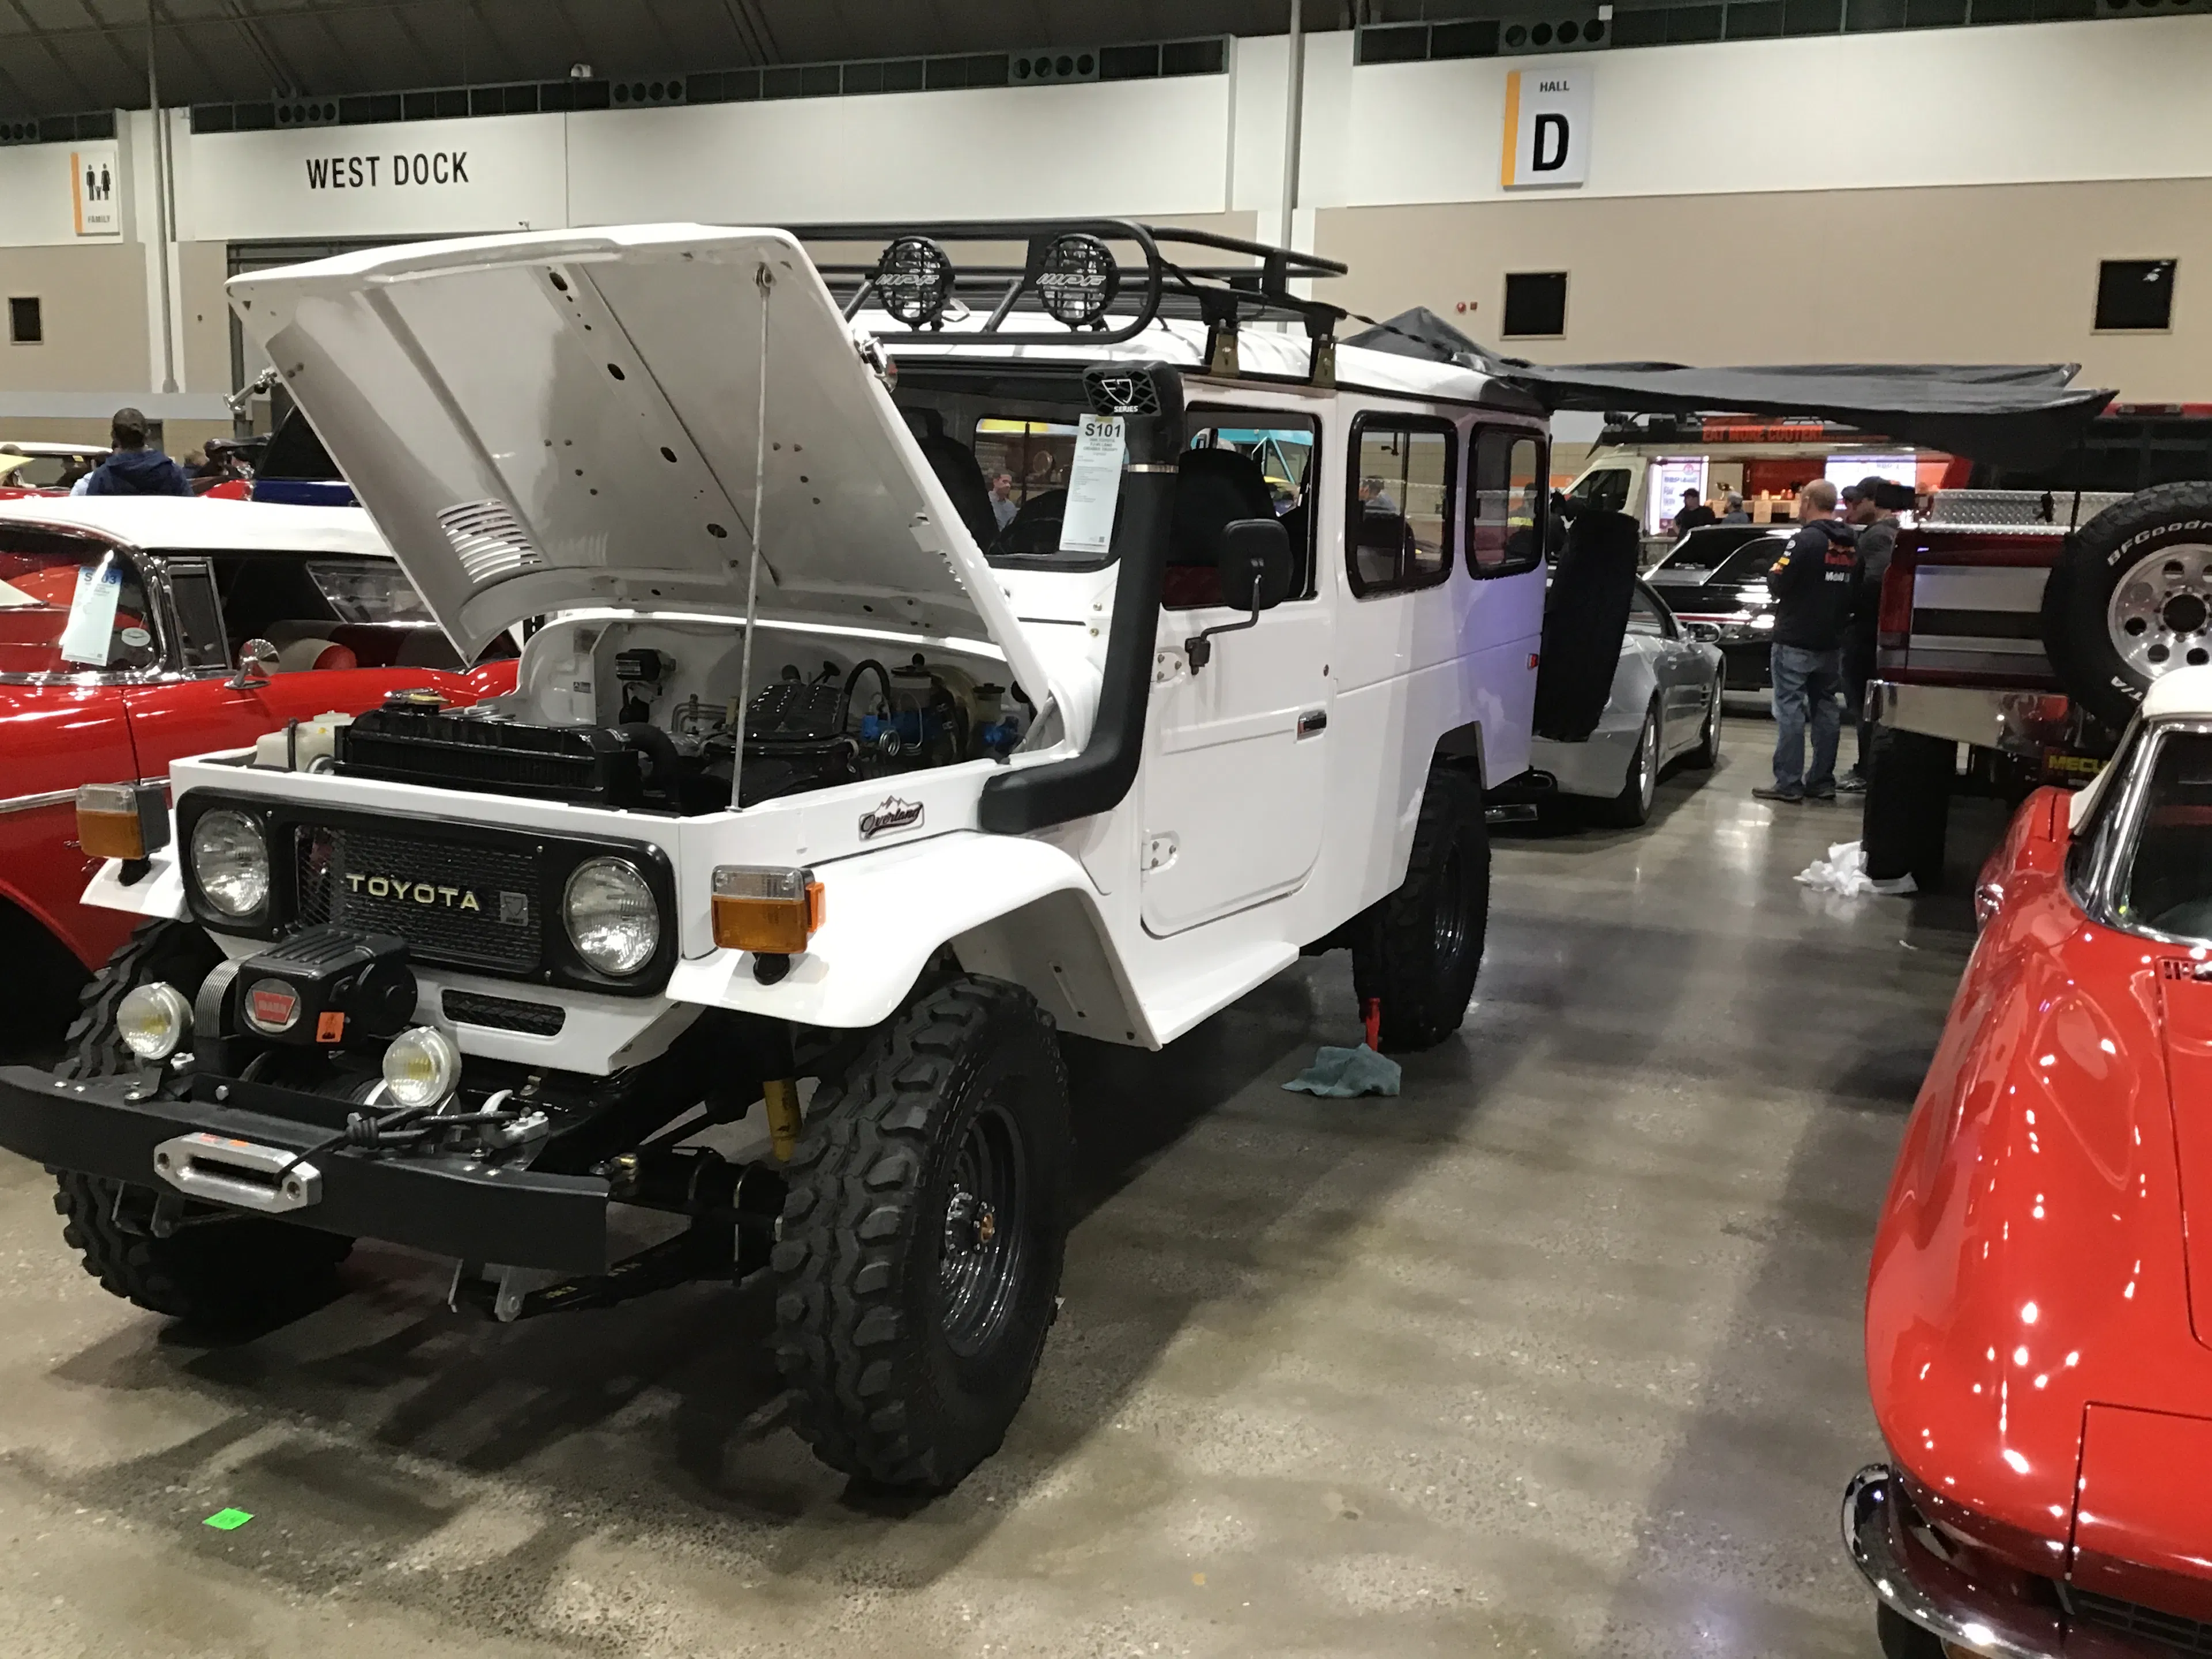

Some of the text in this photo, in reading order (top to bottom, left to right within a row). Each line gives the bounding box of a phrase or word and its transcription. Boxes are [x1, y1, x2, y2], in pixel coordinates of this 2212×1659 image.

[1539, 80, 1570, 93] HALL
[1532, 113, 1570, 172] D
[306, 151, 469, 189] WEST DOCK
[88, 215, 111, 224] FAMILY
[1085, 423, 1121, 438] S101
[84, 572, 116, 585] S03
[346, 873, 480, 911] TOYOTA
